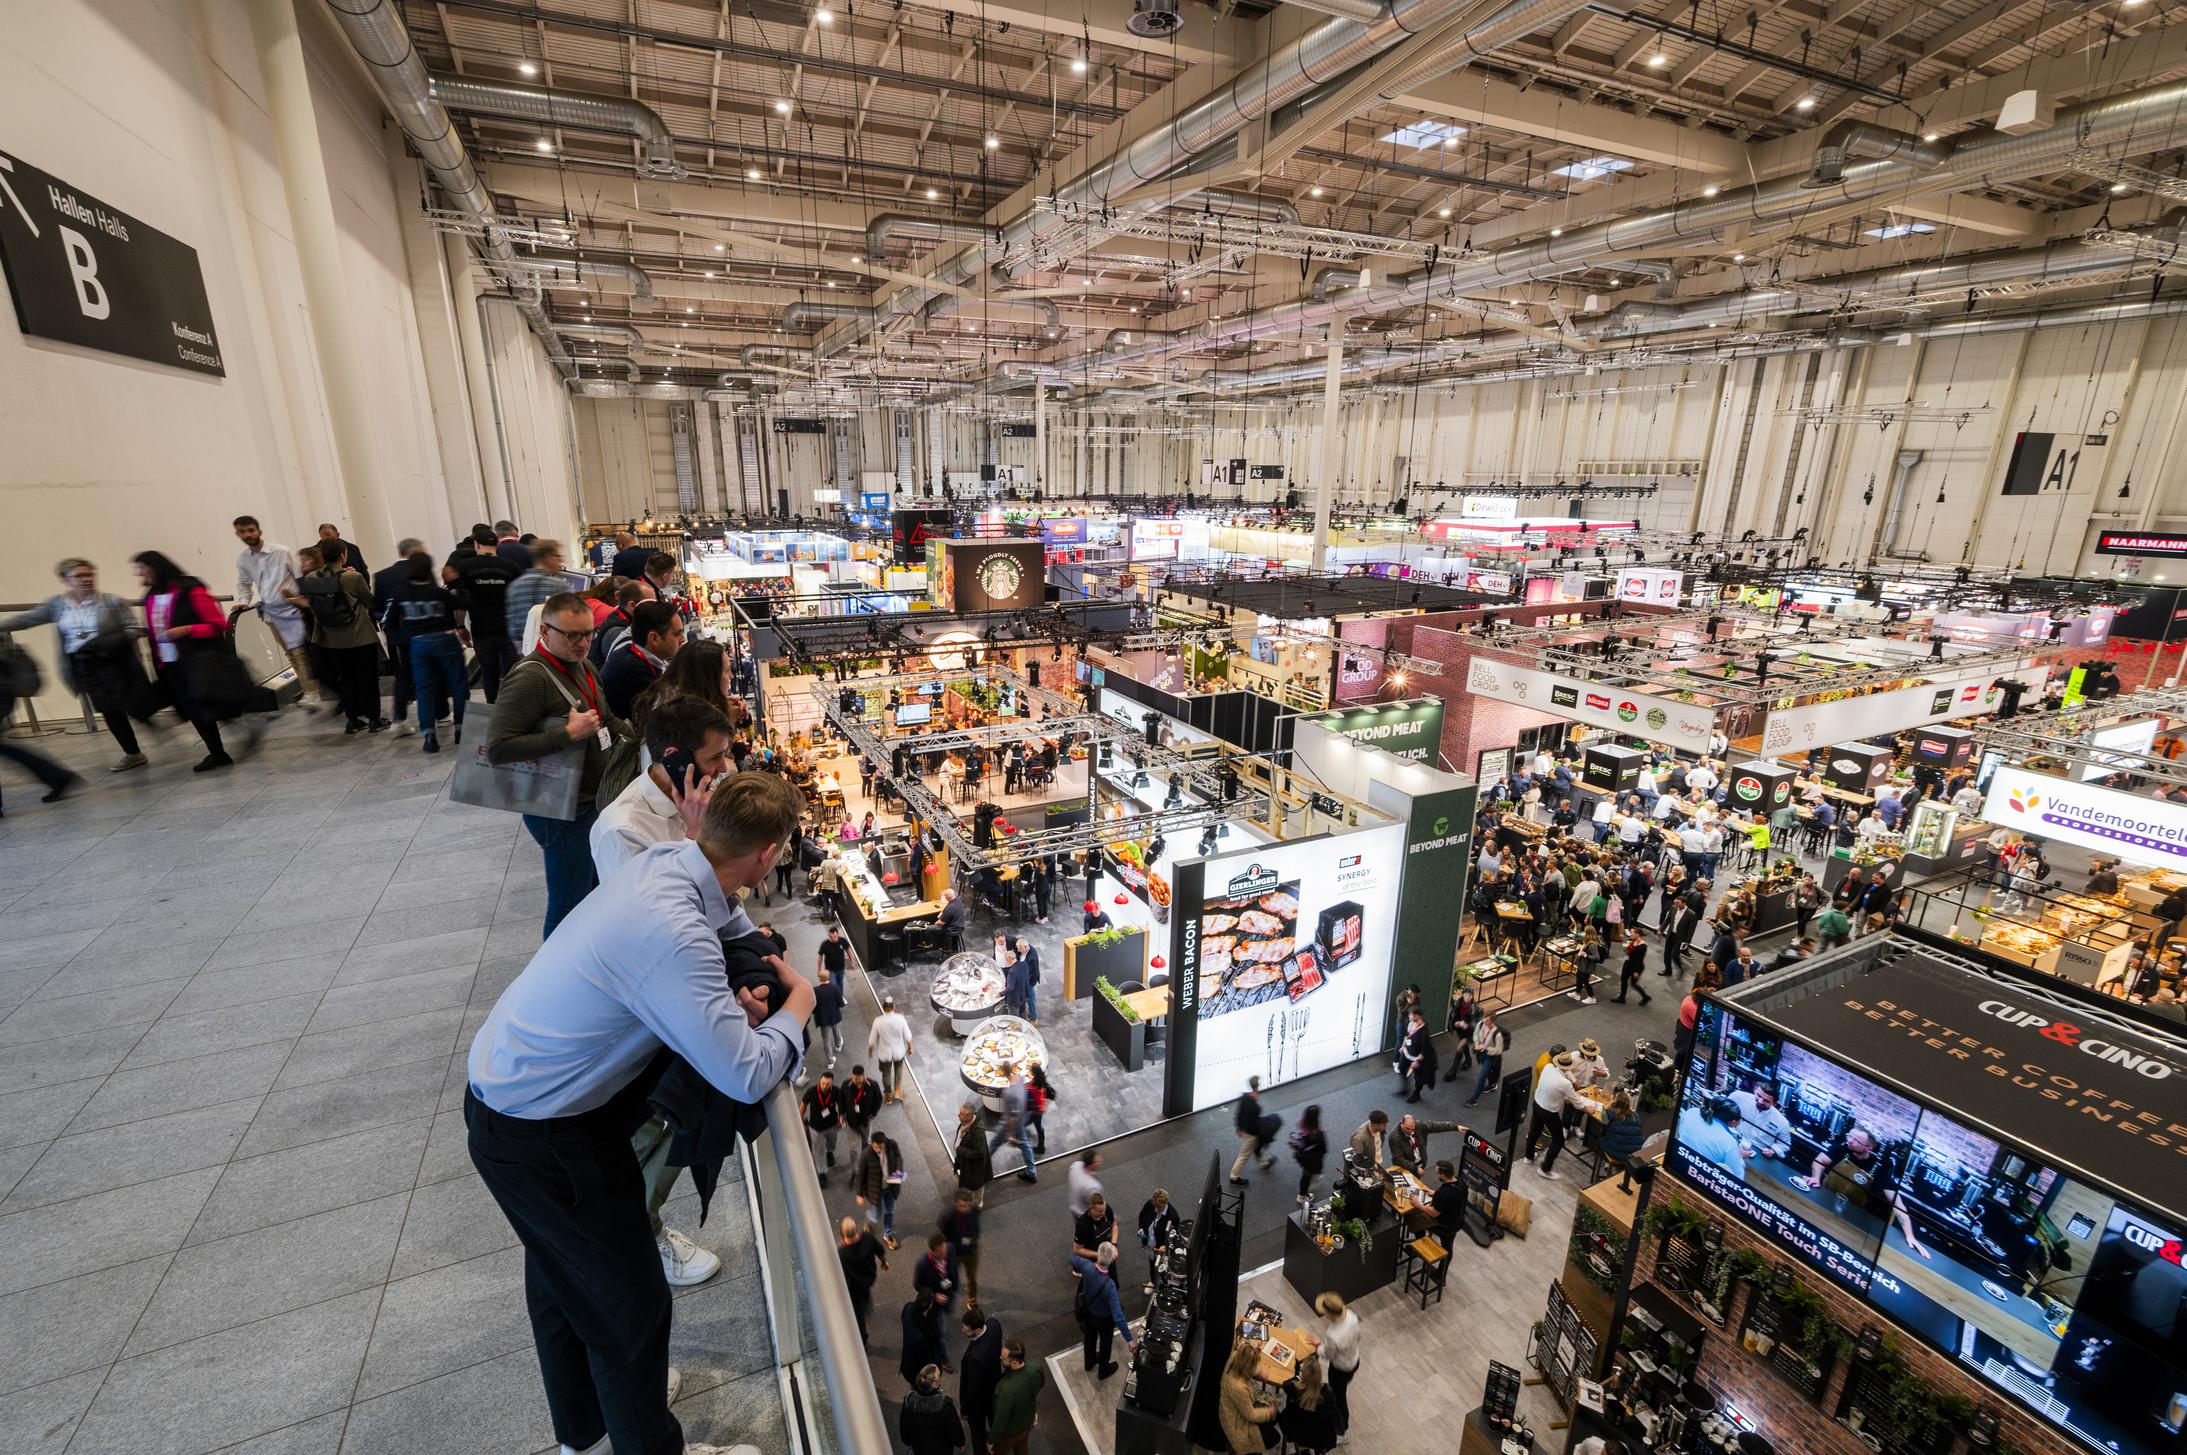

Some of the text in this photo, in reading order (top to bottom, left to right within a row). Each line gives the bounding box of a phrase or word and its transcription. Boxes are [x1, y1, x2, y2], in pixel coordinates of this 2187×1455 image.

[47, 184, 129, 242] Hallen Halls
[58, 224, 110, 320] B
[172, 321, 214, 347] Konferenz A
[178, 345, 223, 369] Conference A
[774, 422, 786, 432] A2
[1002, 428, 1013, 436] A2
[998, 468, 1013, 481] A1
[1212, 465, 1227, 483] A1
[1251, 469, 1263, 478] A2
[2043, 449, 2080, 490] A1
[1341, 669, 1378, 684] GROUP
[1473, 672, 1496, 683] FOOD
[1474, 663, 1491, 674] BELL
[1471, 679, 1500, 692] GROUP
[1392, 720, 1426, 736] MEAT
[1770, 717, 1787, 728] BELL
[1768, 727, 1790, 738] FOOD
[1766, 735, 1792, 750] GROUP
[1589, 763, 1613, 776] BRESC
[2048, 796, 2187, 845] Vandemoortel
[1409, 833, 1469, 854] BEYOND MEAT
[2051, 816, 2180, 853] PROFESSIONAL
[1229, 876, 1277, 891] GIERLINGER
[1337, 868, 1371, 882] SYNERGY
[1182, 919, 1197, 1010] WEBER BACON
[1843, 1000, 1971, 1061] BETTER
[1978, 1000, 2173, 1079] CUP&CINO
[1876, 1000, 2187, 1139] BETTER COFFEE
[1467, 1135, 1502, 1164] CUP&CINO
[1677, 1146, 1901, 1295] Siebträger-Qualität im SB-Bereich
[1687, 1165, 1871, 1290] BaristaONE Touch Serie
